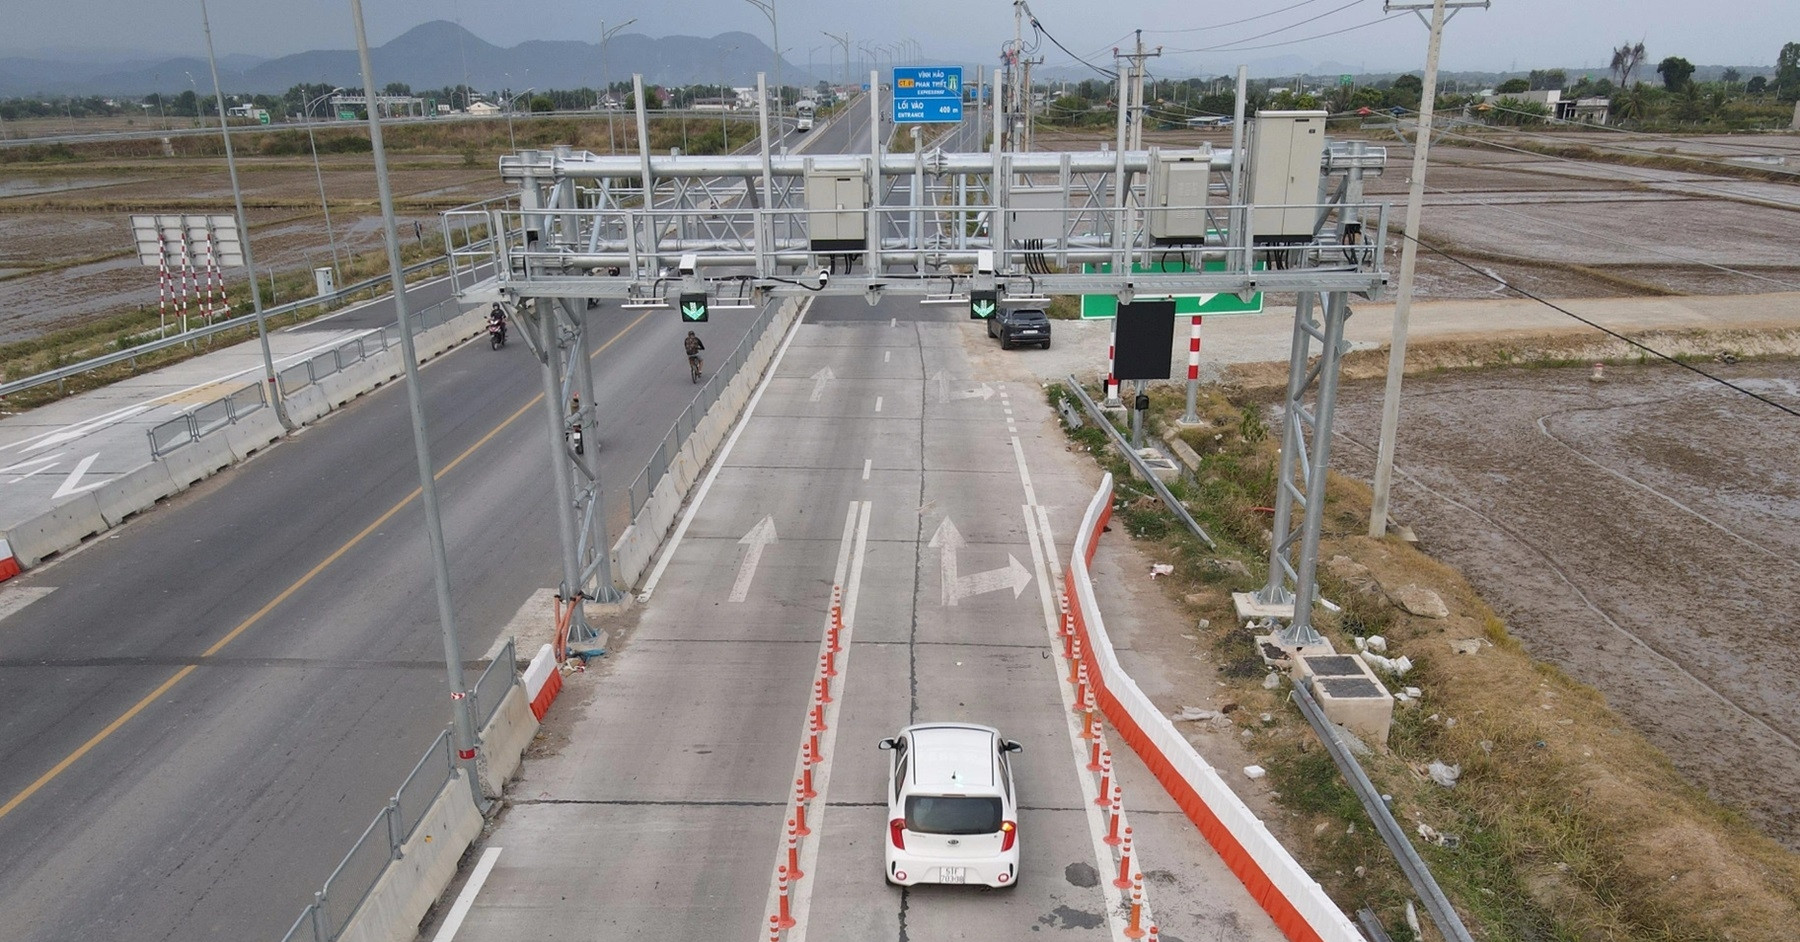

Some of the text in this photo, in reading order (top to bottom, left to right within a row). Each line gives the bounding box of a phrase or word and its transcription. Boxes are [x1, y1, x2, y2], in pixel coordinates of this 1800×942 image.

[897, 99, 924, 110] LỐI VÀO
[939, 106, 951, 114] 400
